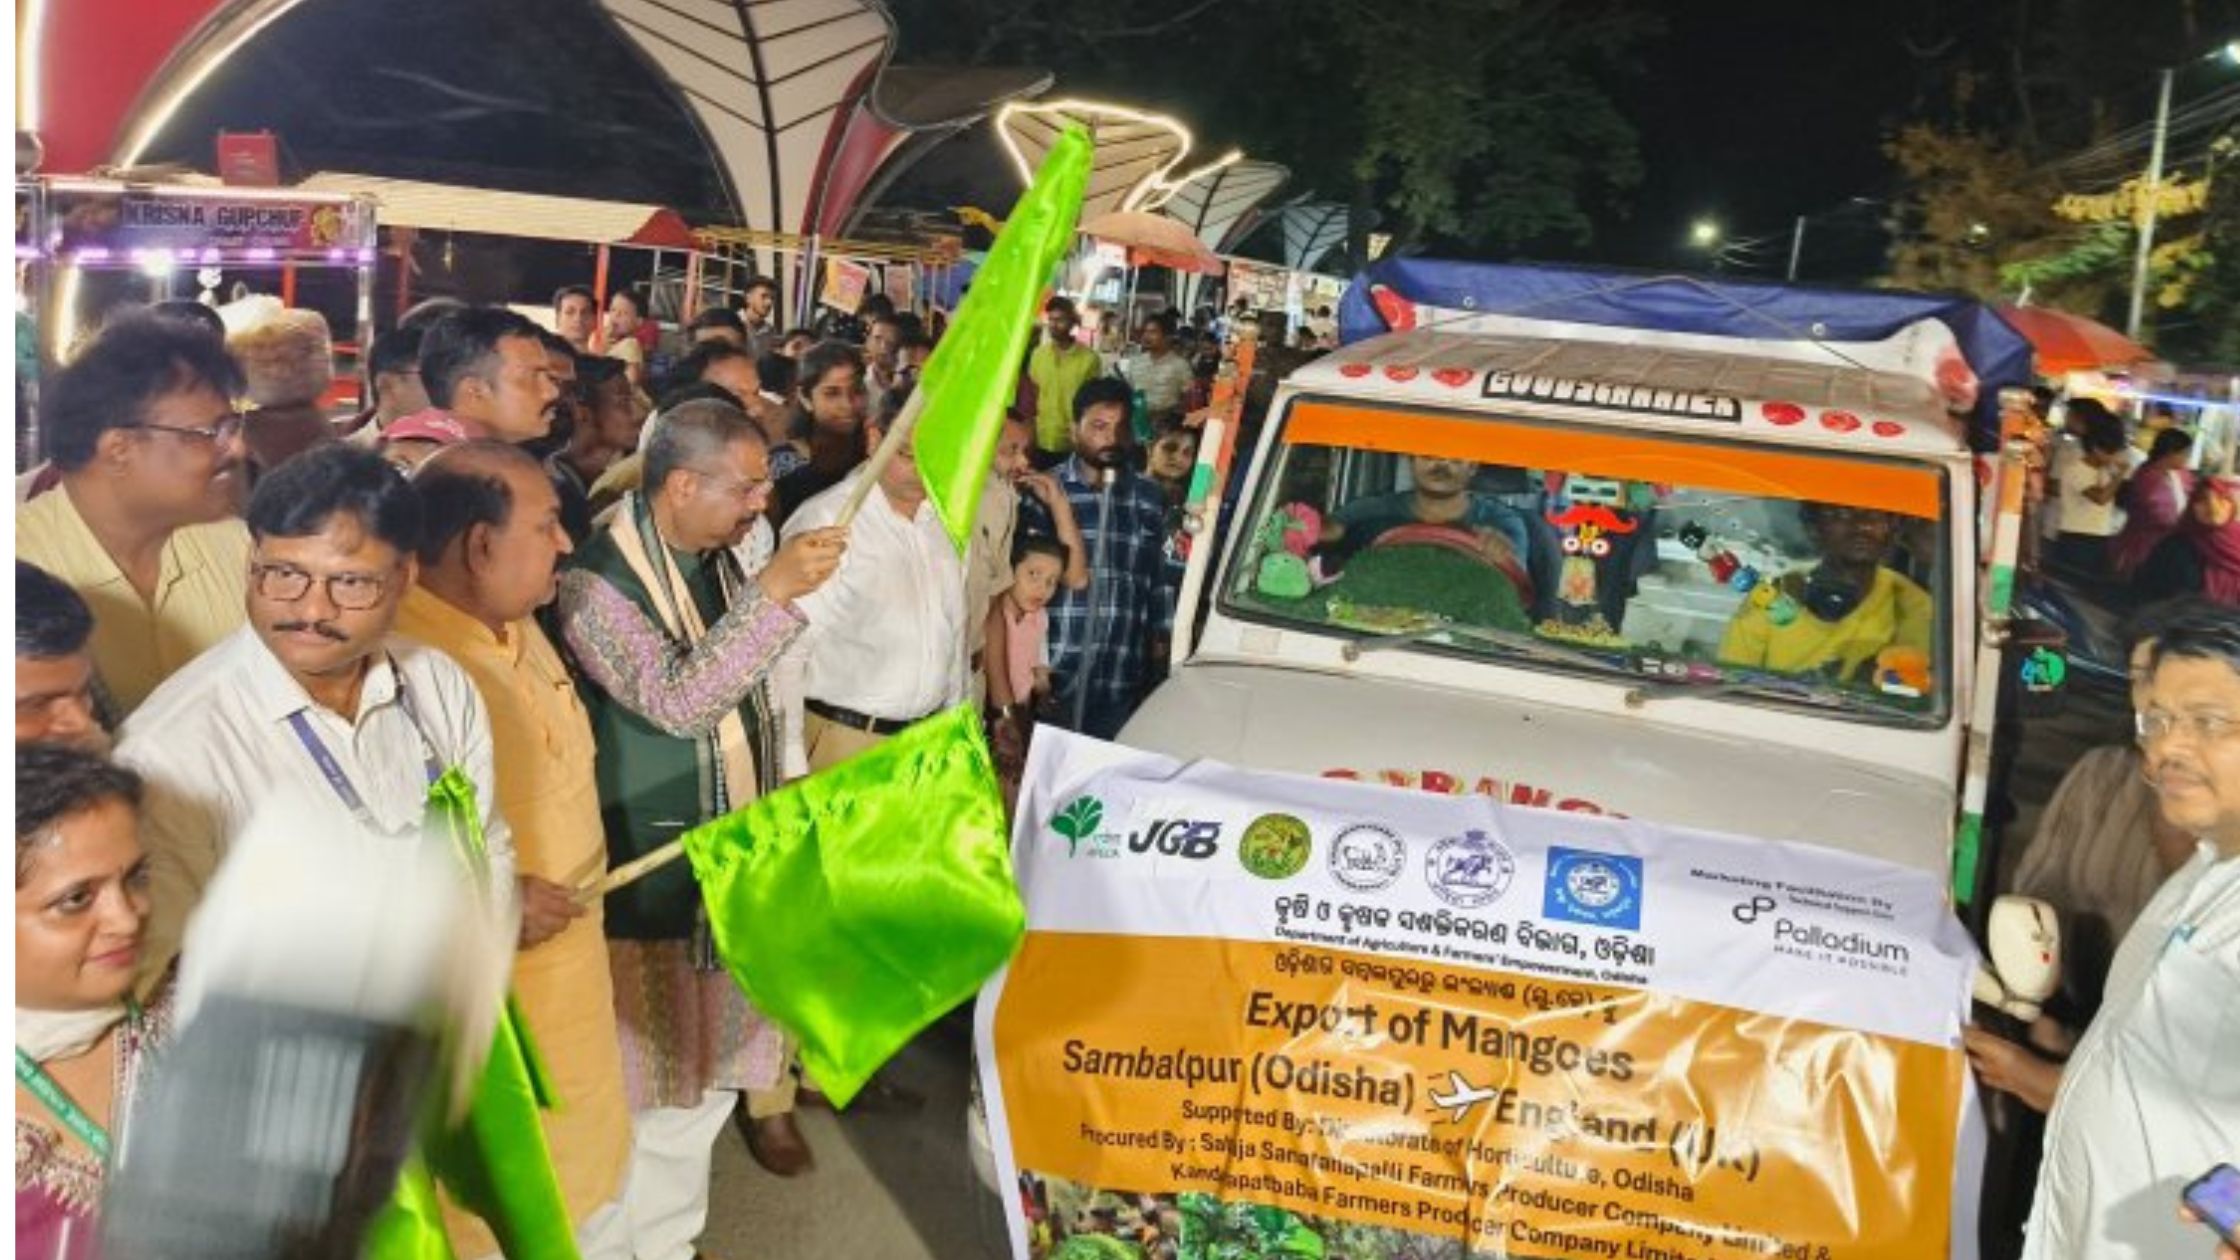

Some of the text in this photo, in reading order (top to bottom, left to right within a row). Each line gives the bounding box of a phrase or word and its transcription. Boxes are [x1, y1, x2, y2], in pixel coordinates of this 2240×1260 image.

[1128, 819, 1223, 859] JGB
[1773, 918, 1910, 963] Palladium
[1246, 991, 1634, 1082] Export of Mangoes
[1063, 1040, 1760, 1183] Sambalpur (Odisha) Engand (U)
[1081, 1122, 1158, 1149] Procured
[1161, 1129, 1186, 1154] By
[1496, 1182, 1600, 1219] Producer
[1604, 1200, 1714, 1246] Compy
[1470, 1139, 1607, 1189] Hortultue,
[1613, 1168, 1695, 1202] Odisha
[1323, 1187, 1412, 1218] Farmers
[1418, 1201, 1504, 1237] Prodcer
[1510, 1219, 1622, 1259] Company
[1627, 1240, 1714, 1260] Limit
